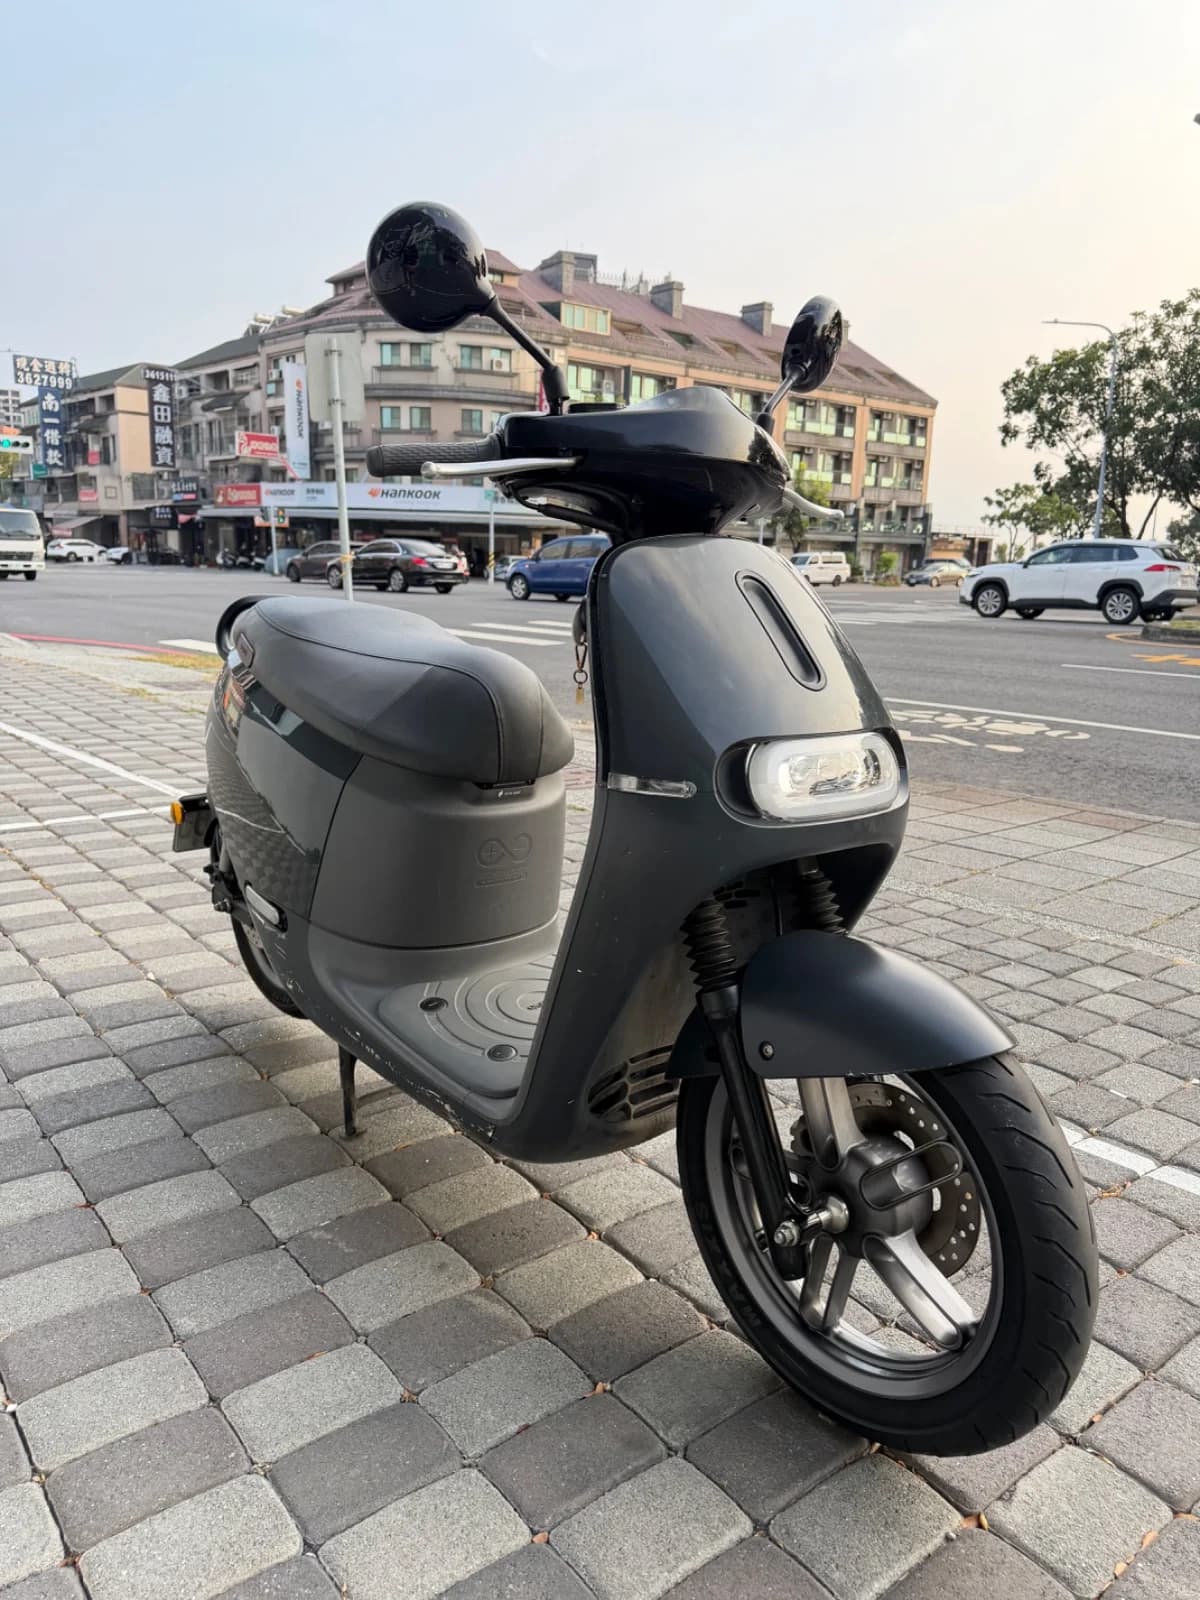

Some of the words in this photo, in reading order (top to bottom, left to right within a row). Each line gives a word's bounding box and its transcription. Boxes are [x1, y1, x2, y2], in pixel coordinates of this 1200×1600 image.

[17, 371, 73, 389] 3627999
[42, 393, 64, 466] 南一借款
